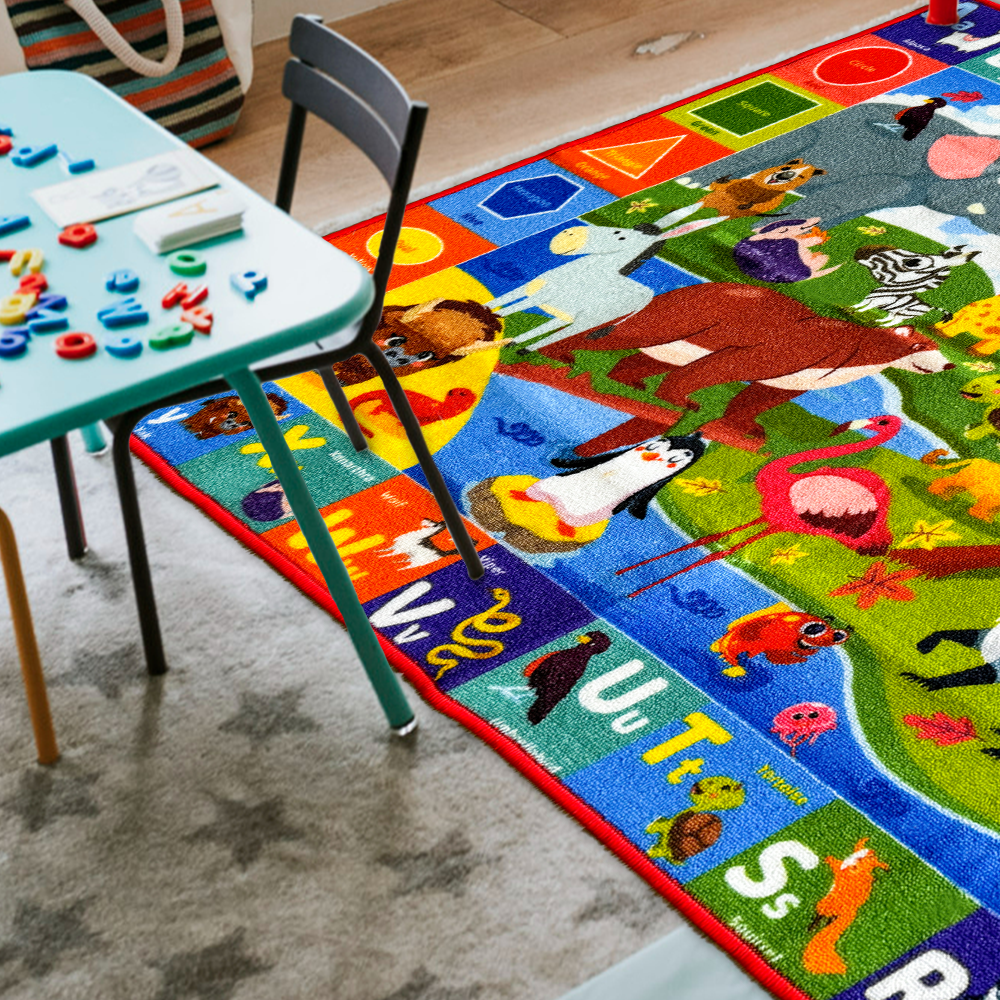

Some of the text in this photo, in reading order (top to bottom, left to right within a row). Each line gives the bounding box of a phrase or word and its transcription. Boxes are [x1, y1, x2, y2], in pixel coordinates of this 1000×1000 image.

[380, 490, 409, 508] Wolf
[368, 580, 456, 644] Vv
[577, 659, 669, 735] Uu
[641, 712, 733, 785] Tt
[724, 840, 819, 920] Ss
